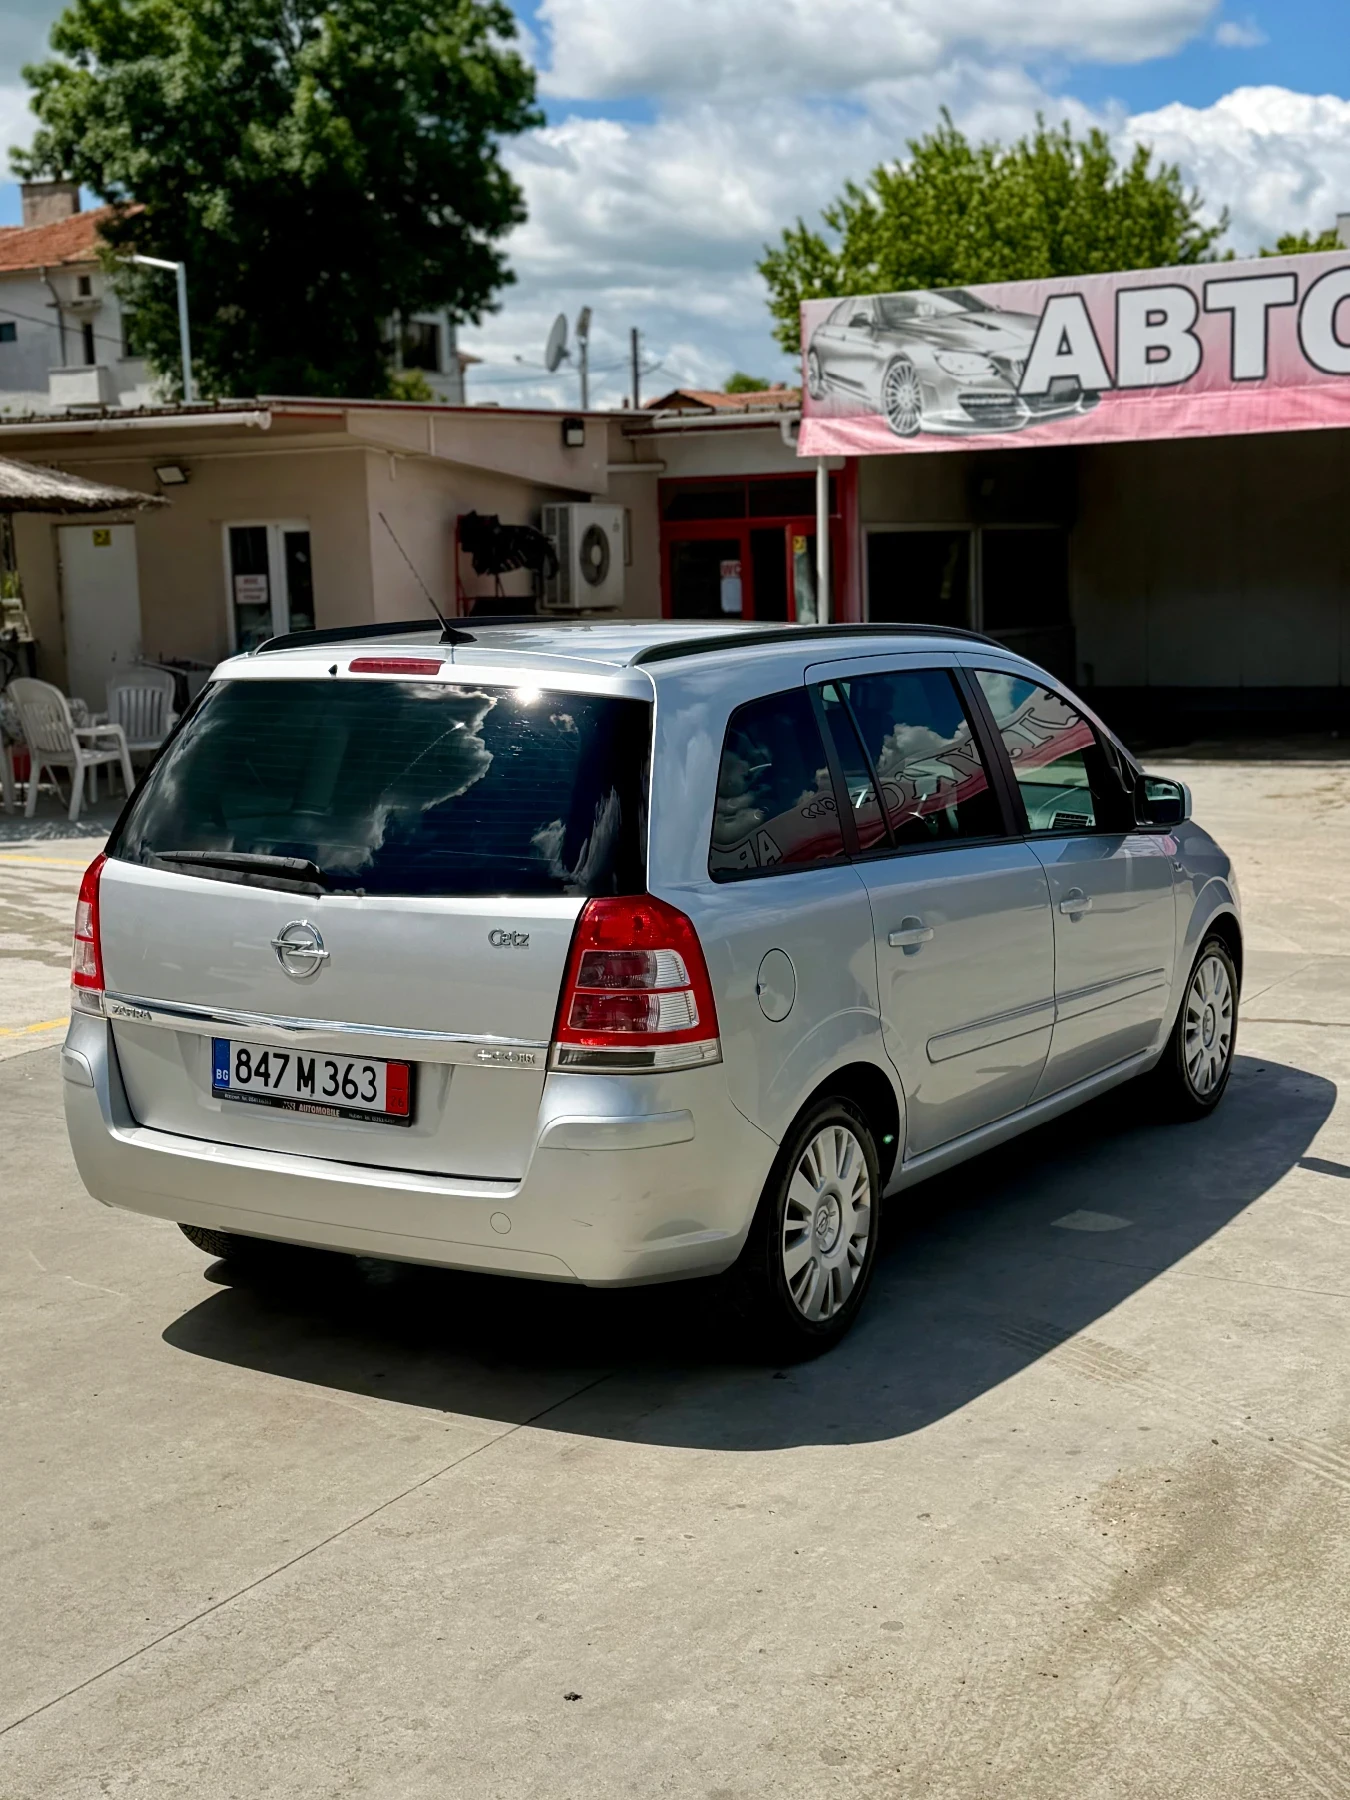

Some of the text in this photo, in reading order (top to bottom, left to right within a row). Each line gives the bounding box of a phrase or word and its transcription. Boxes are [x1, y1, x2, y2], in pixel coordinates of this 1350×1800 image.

[216, 1069, 229, 1081] BG
[235, 1048, 290, 1089] 847
[322, 1060, 377, 1102] 363
[298, 1104, 340, 1118] AUTOMOBILE
